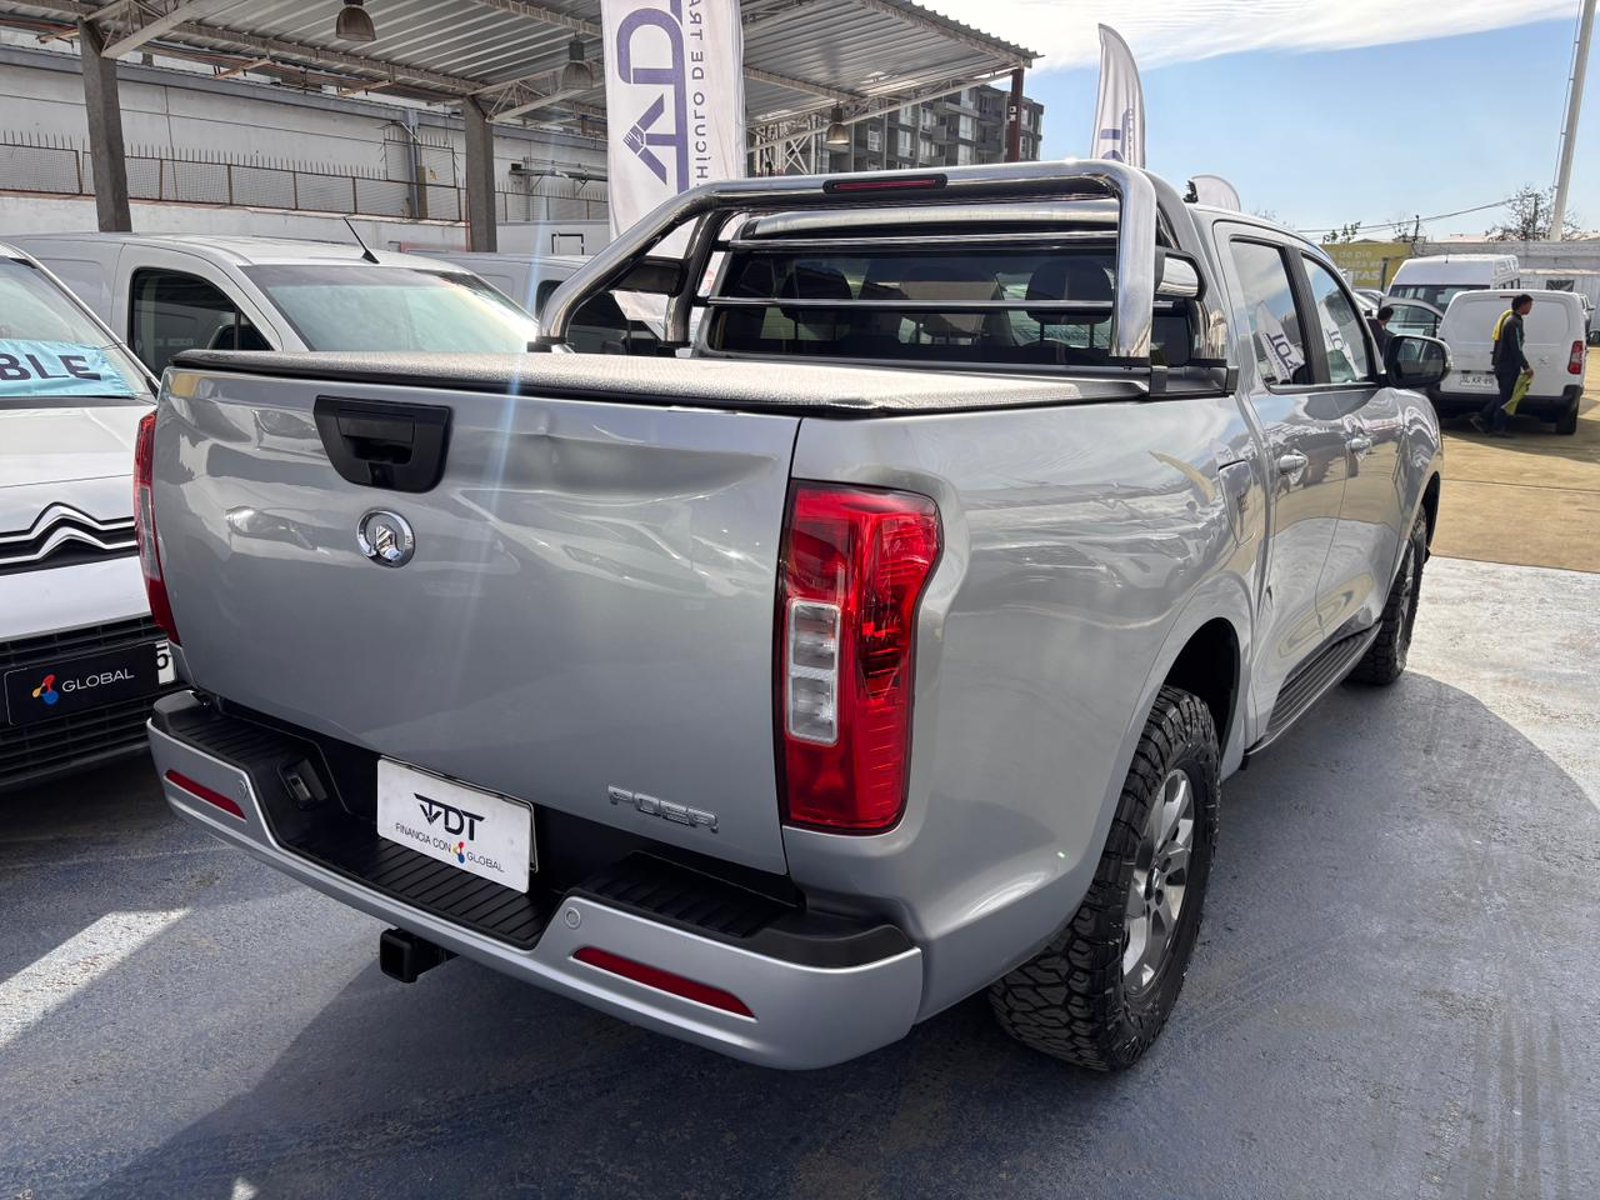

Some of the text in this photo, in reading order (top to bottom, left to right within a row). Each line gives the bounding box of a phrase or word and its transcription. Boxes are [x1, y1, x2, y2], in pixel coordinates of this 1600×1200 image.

[62, 668, 135, 693] GLOBAL
[414, 793, 485, 840] VDT
[396, 824, 504, 873] FINANCIA CON GLOBAL
